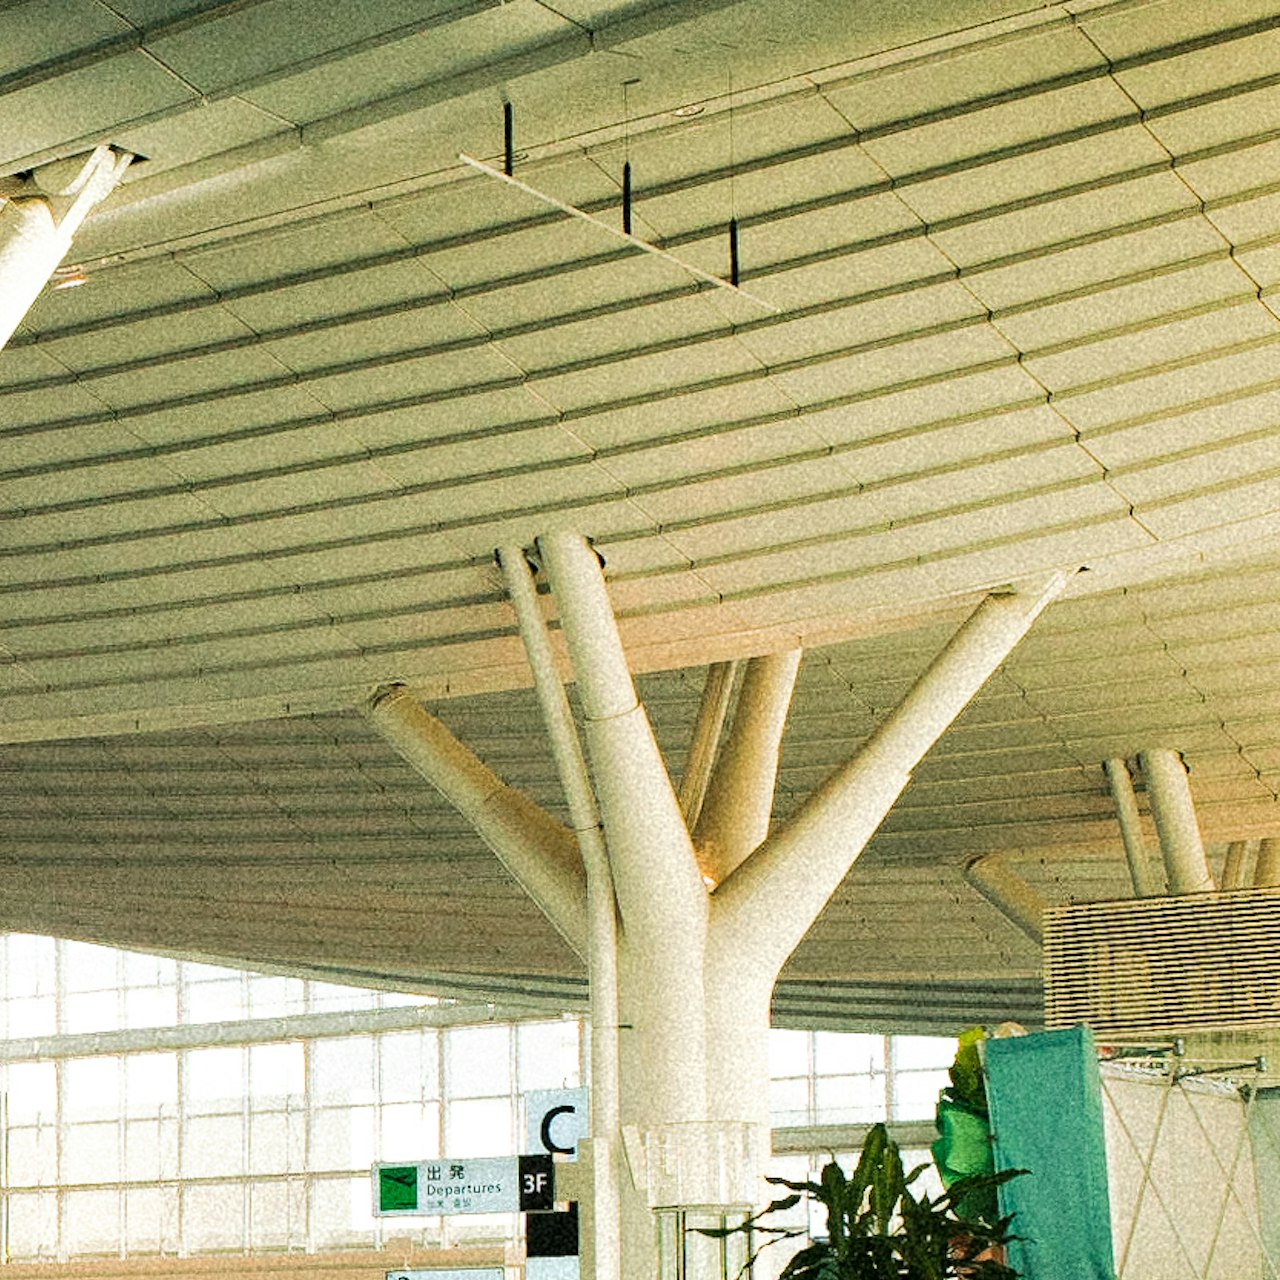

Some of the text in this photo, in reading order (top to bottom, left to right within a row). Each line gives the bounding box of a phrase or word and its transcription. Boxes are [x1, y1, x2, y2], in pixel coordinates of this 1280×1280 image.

[539, 1104, 576, 1155] C
[426, 1182, 502, 1198] Departures
[523, 1173, 548, 1195] 3F
